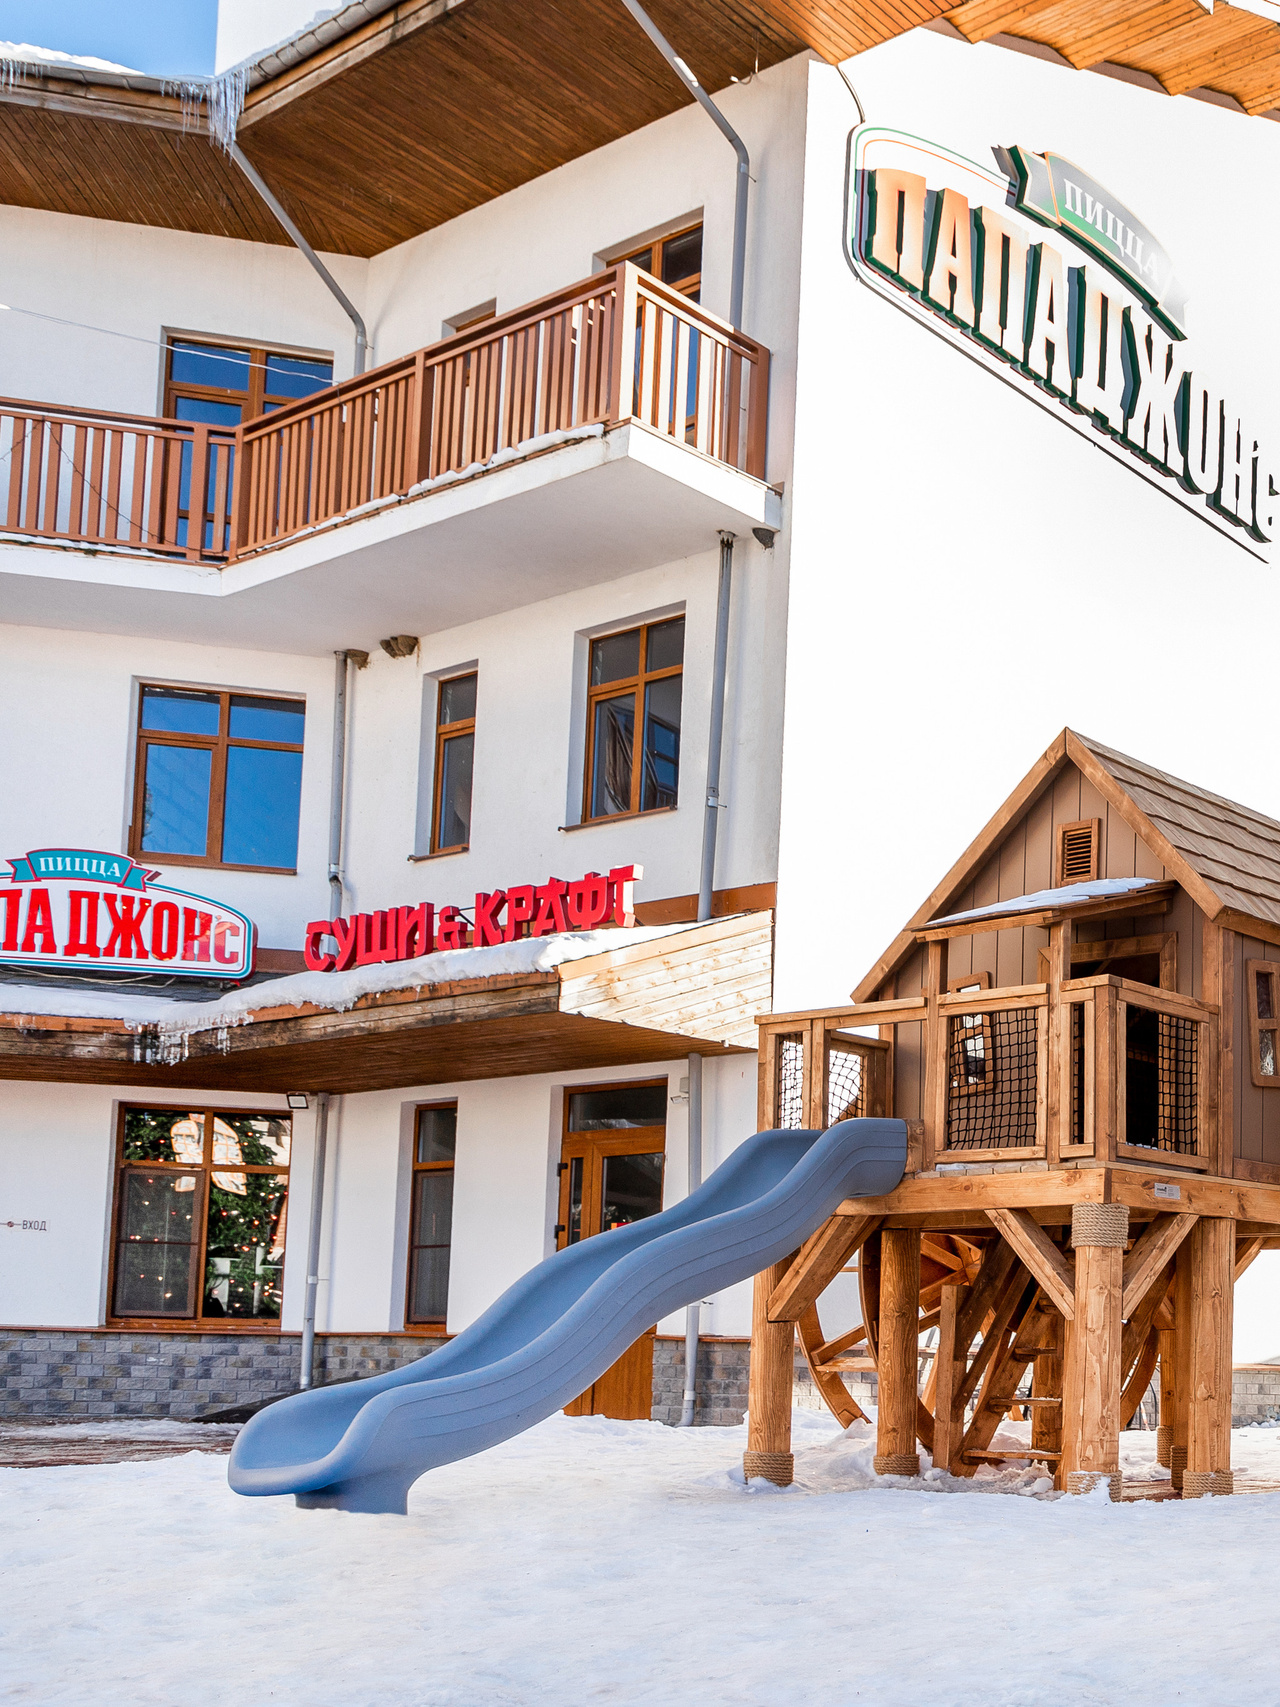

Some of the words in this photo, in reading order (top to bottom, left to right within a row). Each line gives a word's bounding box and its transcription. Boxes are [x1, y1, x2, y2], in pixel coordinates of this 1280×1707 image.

[1064, 178, 1160, 283] ПИЦЦА
[869, 168, 1074, 401] ПАПА
[39, 857, 121, 878] ПИЦЦА
[304, 901, 434, 971] СУШИ
[437, 906, 468, 949] &
[473, 864, 643, 947] КРАФТ
[22, 1220, 47, 1231] ВХОД
